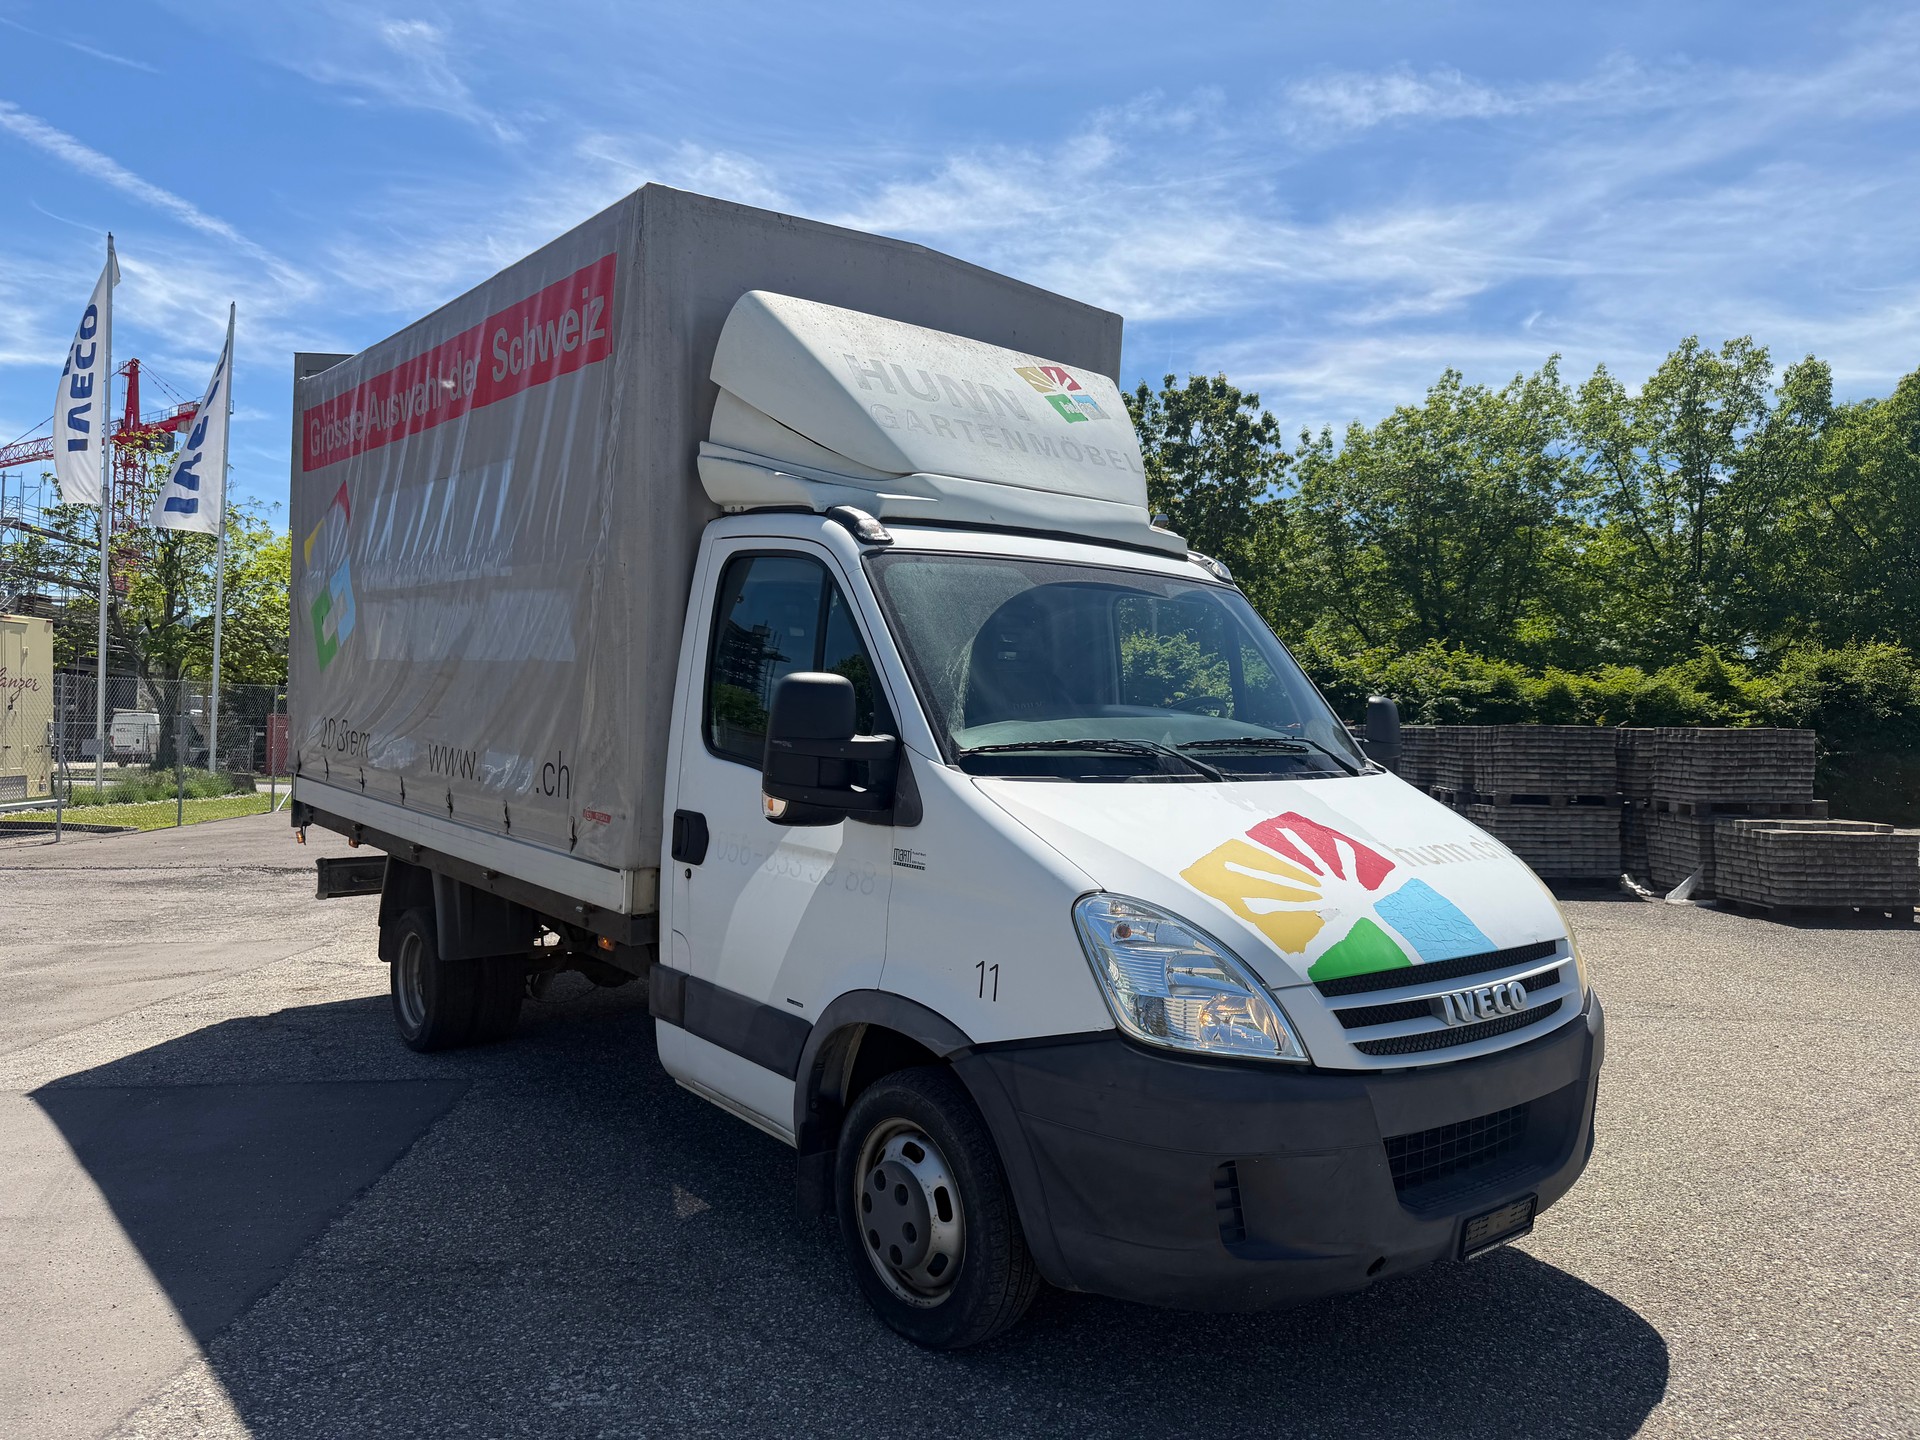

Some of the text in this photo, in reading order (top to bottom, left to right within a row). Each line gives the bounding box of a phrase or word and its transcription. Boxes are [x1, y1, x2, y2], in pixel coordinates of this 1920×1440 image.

[67, 304, 98, 452] IVECO
[309, 286, 605, 458] Grösste Auswahl der Schweiz
[843, 353, 1031, 421] HUNN
[870, 403, 1142, 474] GARTENMÖBEL
[975, 960, 999, 1002] 11
[1441, 980, 1528, 1026] IVECO
